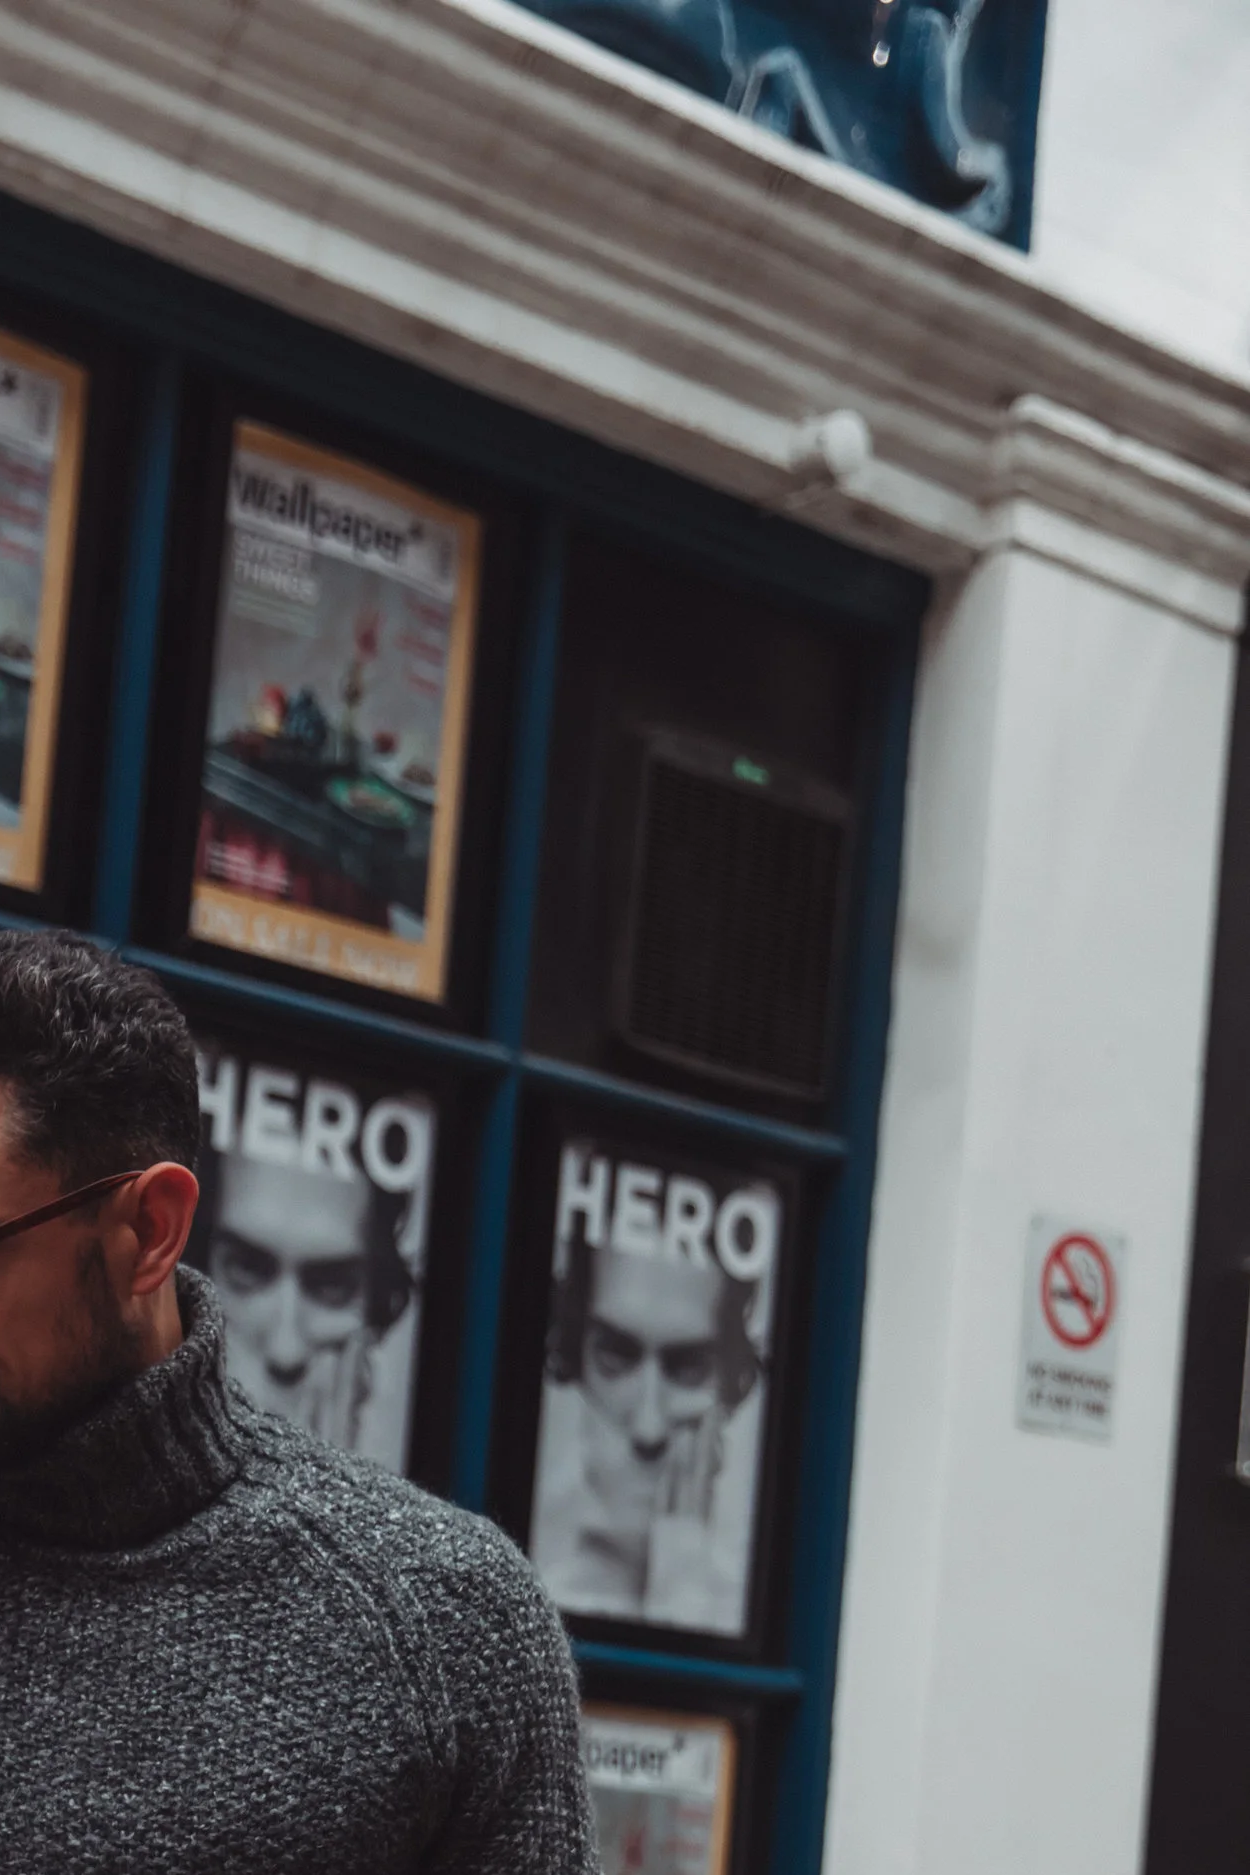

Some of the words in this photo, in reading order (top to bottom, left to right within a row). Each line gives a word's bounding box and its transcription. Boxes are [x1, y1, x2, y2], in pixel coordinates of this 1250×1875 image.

[196, 1052, 435, 1193] HERO
[555, 1147, 776, 1283] HERO
[585, 1731, 685, 1780] paper
